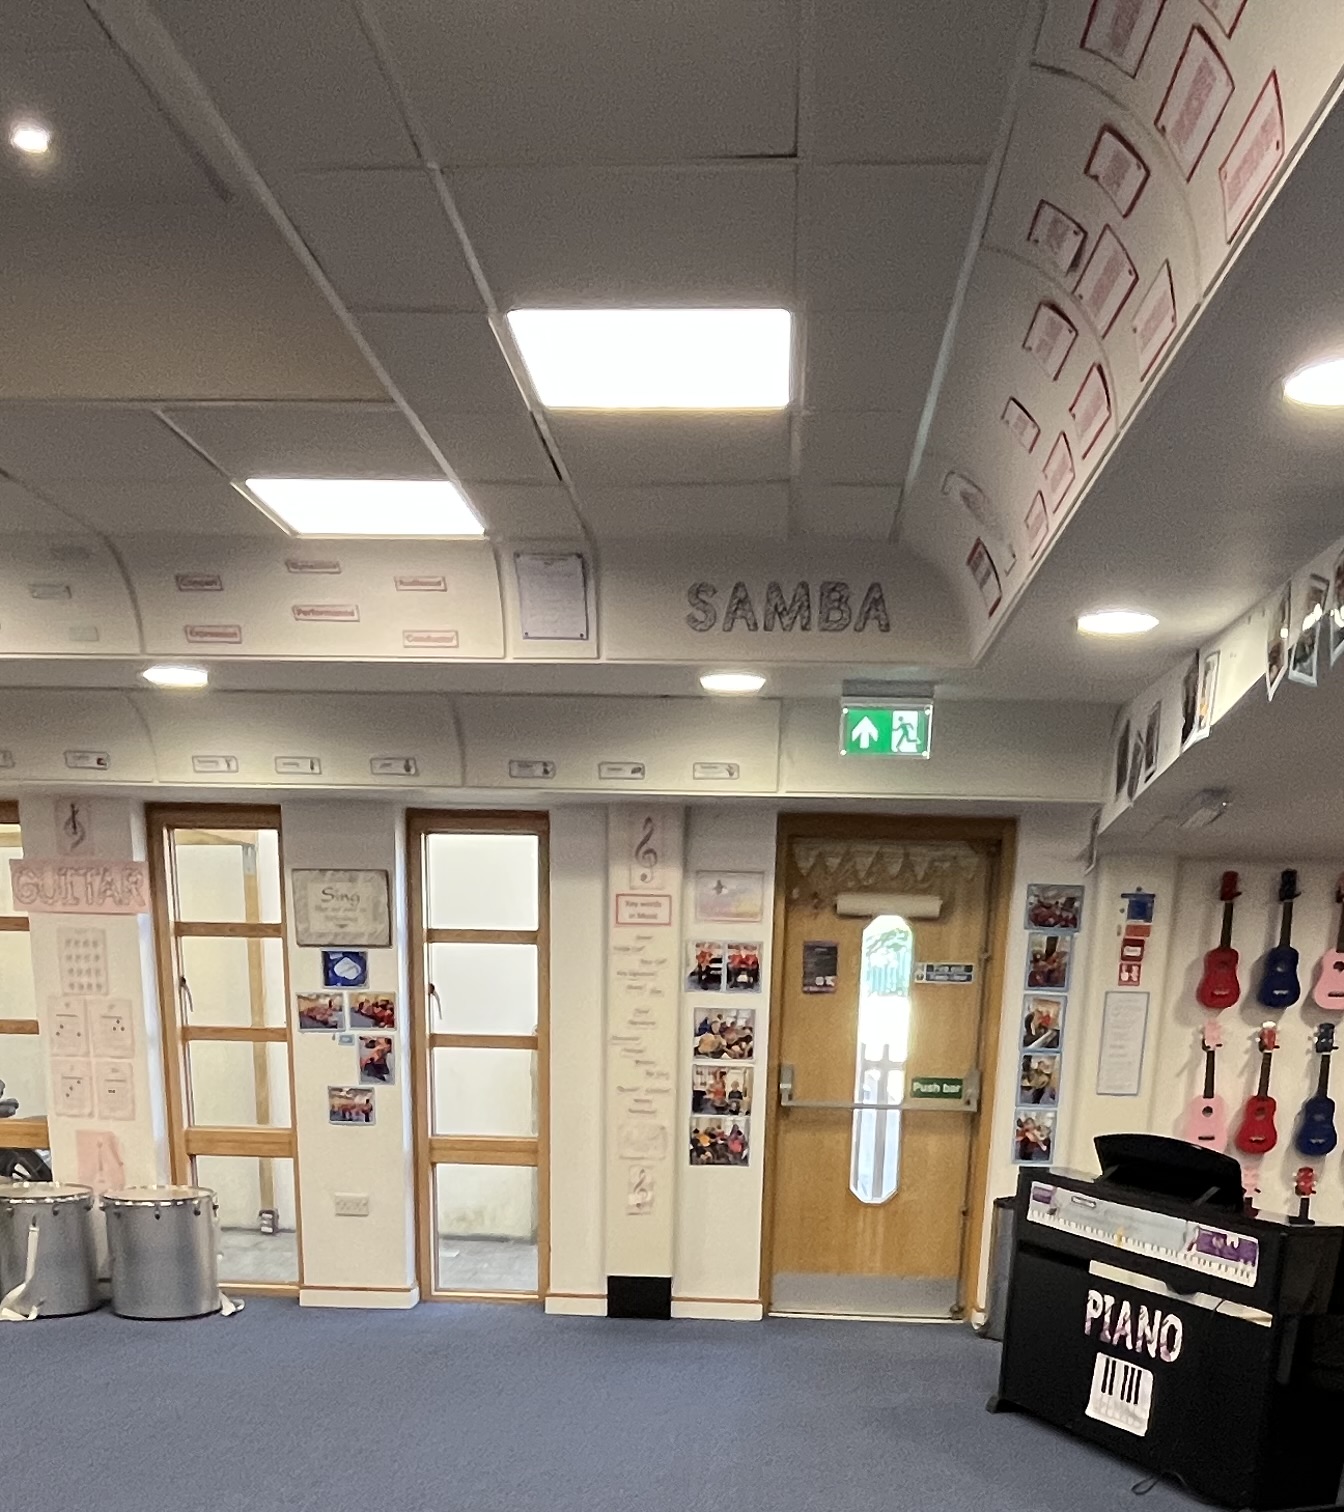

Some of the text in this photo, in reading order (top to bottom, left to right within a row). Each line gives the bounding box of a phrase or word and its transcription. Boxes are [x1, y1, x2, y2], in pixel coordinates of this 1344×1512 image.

[687, 580, 891, 633] SAMBA
[14, 865, 147, 908] GUITAR
[321, 886, 360, 908] Sing
[912, 1081, 961, 1094] Push bar
[1085, 1289, 1184, 1363] PIANO
